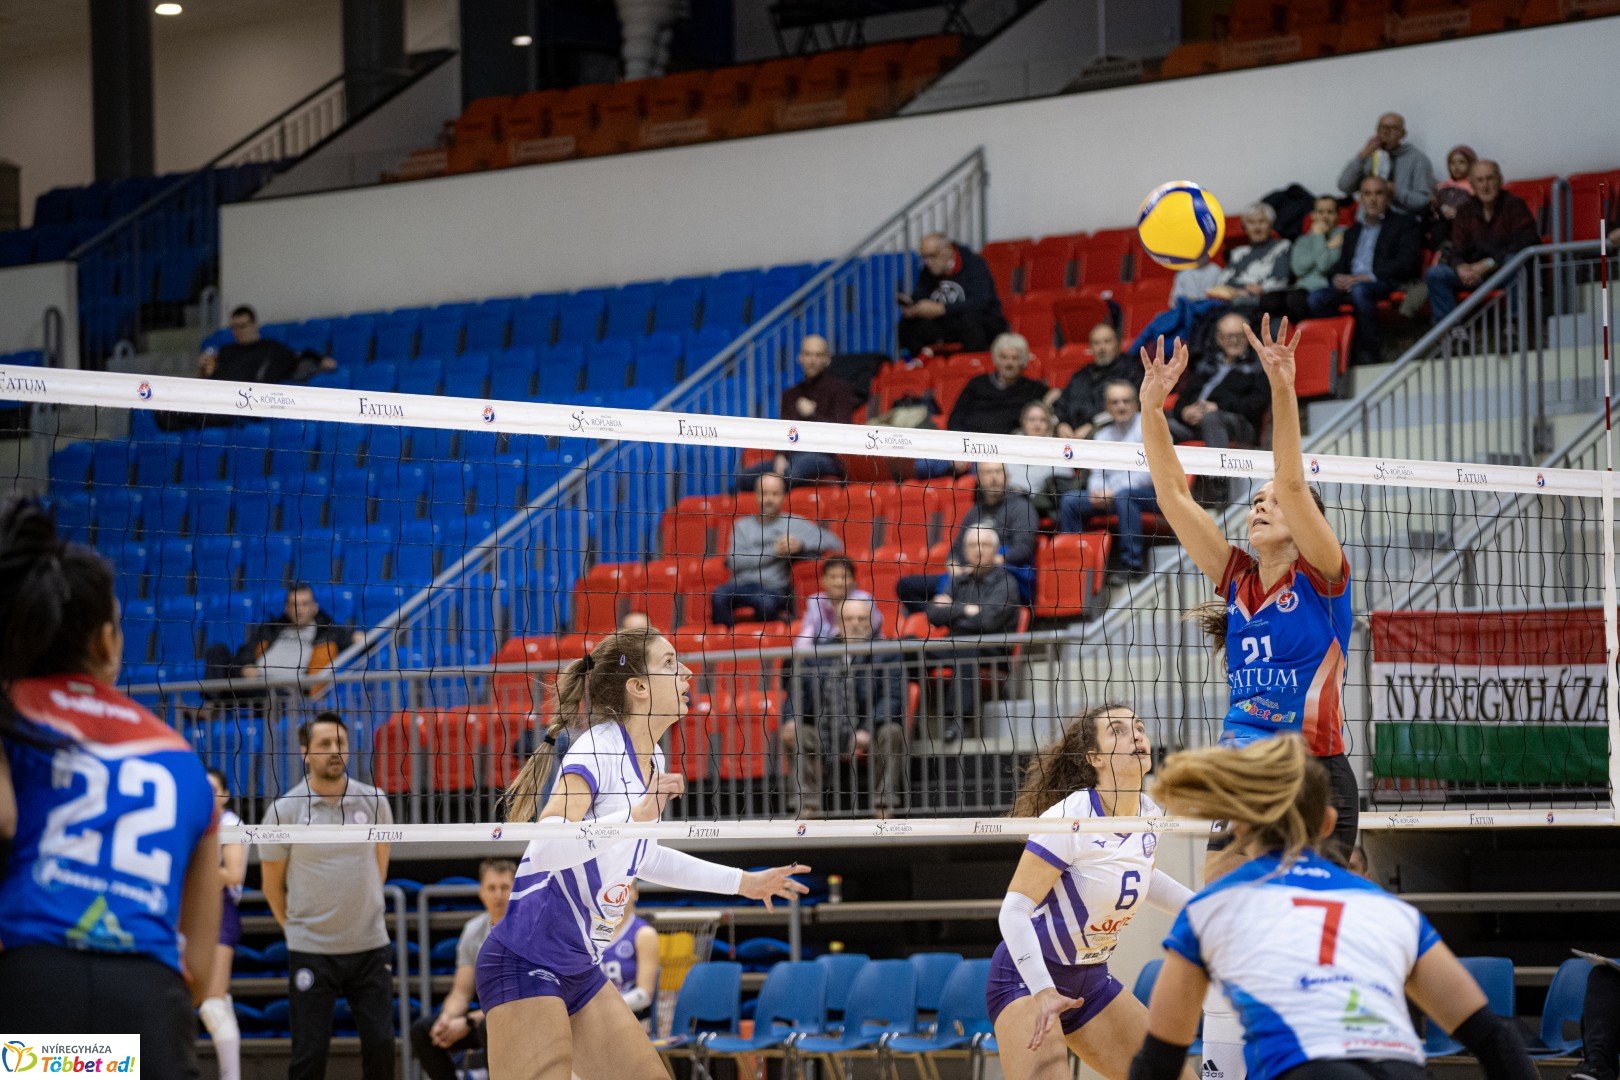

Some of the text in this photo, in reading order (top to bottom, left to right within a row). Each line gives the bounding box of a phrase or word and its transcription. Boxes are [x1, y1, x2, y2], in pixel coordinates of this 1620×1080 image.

[358, 397, 405, 417] FATUM
[678, 419, 718, 438] FATUM
[962, 438, 999, 455] FATUM
[1219, 453, 1254, 471] FATUM
[1456, 468, 1488, 485] FATUM
[1241, 635, 1273, 665] 21
[1384, 667, 1609, 722] NYÍREGYHÁZA
[38, 748, 177, 885] 22
[1469, 813, 1495, 826] FATUM
[367, 827, 404, 842] FATUM
[688, 824, 720, 838] FATUM
[972, 821, 1002, 834] FATUM
[1115, 870, 1141, 911] 6
[1291, 896, 1345, 967] 7
[600, 960, 624, 985] 9
